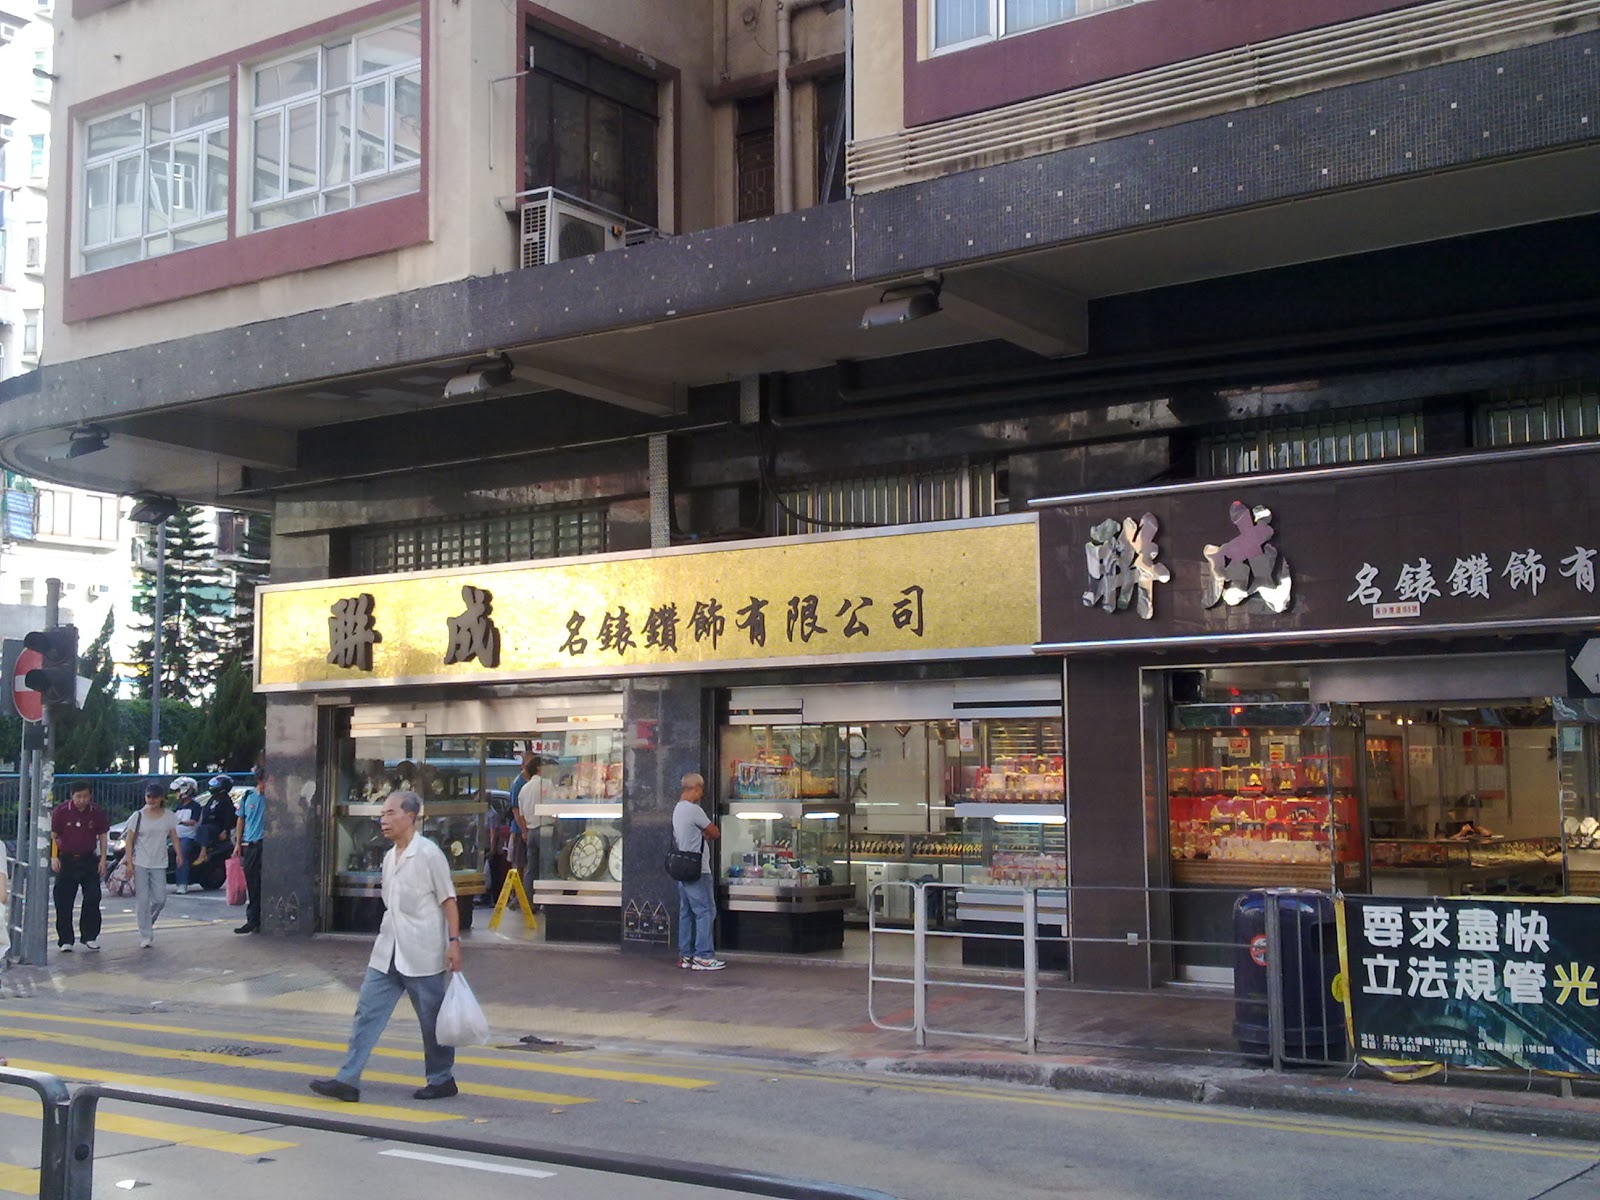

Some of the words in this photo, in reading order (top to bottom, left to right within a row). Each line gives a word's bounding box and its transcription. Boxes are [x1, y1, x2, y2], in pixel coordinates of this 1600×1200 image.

[559, 584, 925, 656] 名錶鑽飾有限公司
[1362, 904, 1550, 953] 要求盡快
[1362, 953, 1600, 1007] 立法規管光
